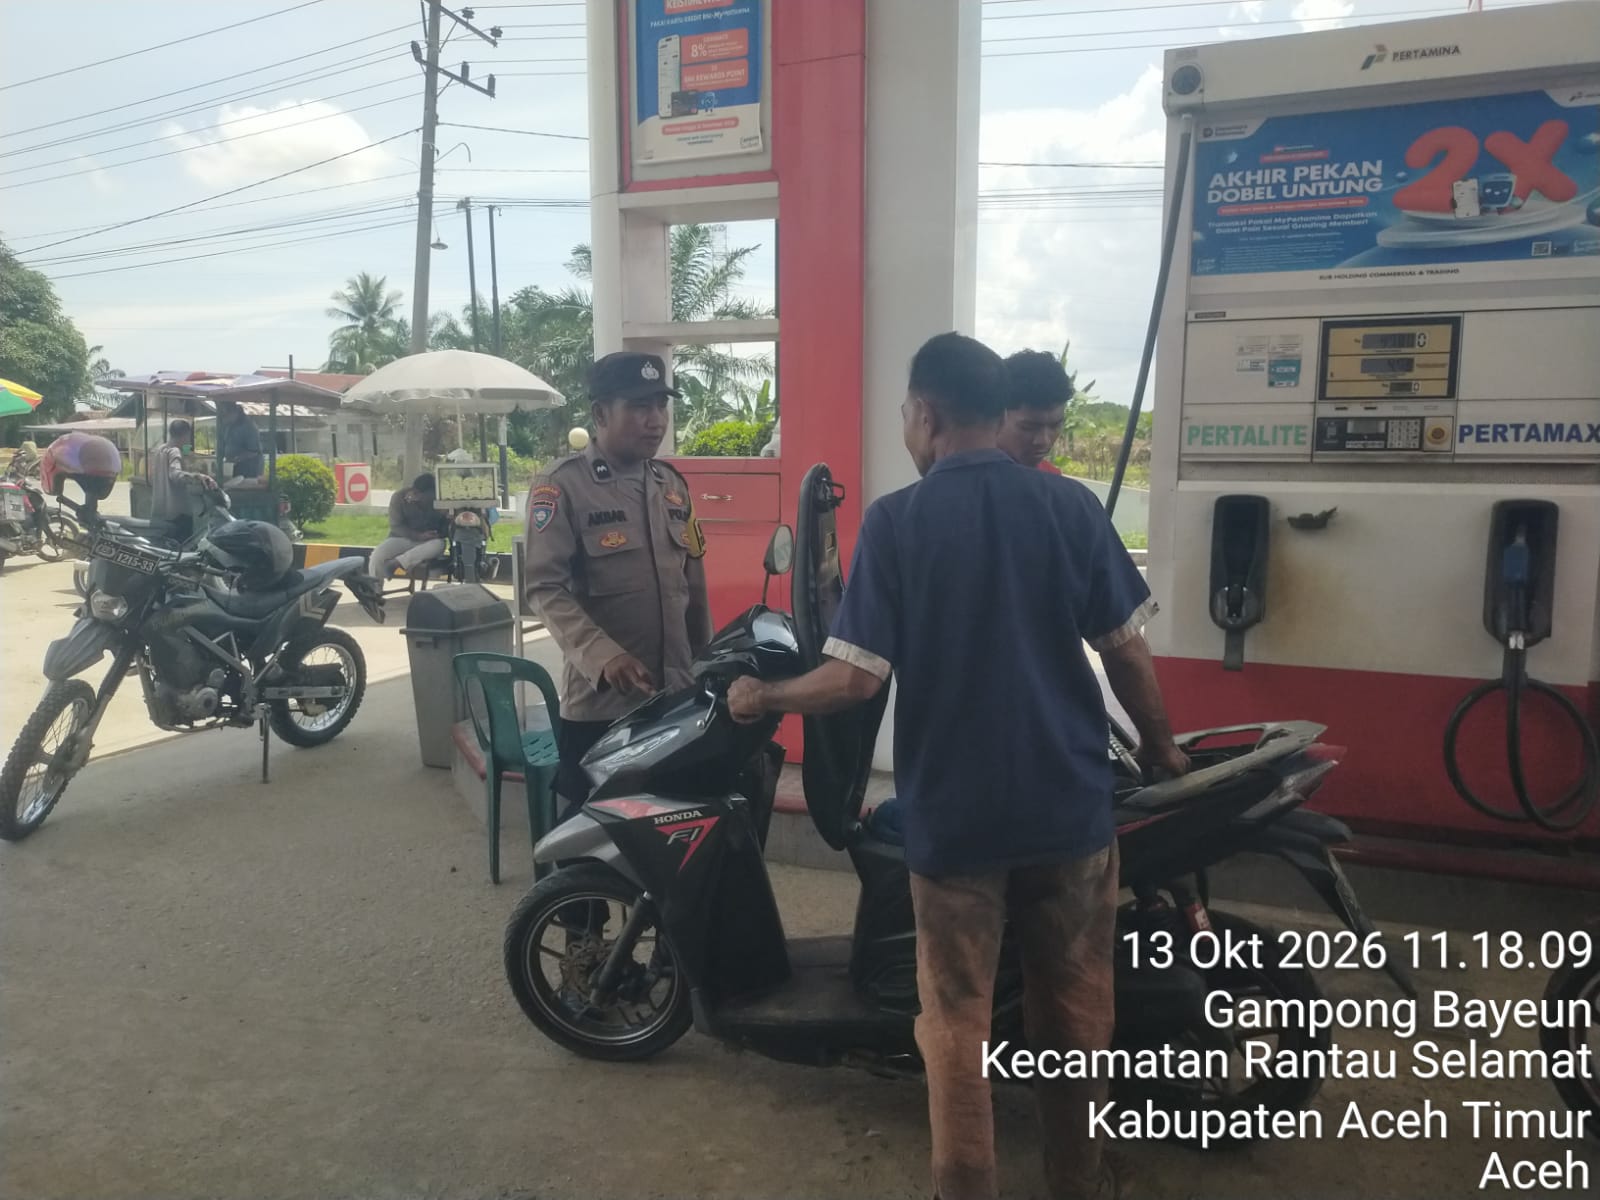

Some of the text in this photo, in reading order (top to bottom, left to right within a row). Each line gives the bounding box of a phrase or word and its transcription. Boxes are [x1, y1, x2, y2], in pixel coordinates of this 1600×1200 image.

[691, 41, 708, 57] 8%
[1392, 45, 1461, 62] PERTAMINA
[1208, 159, 1383, 189] AKHIR PEKAN
[1392, 119, 1579, 215] 2X
[1207, 177, 1384, 204] DOBEL UNTUNG
[1334, 272, 1368, 280] HOLDING
[1369, 271, 1417, 279] COMMERCIAL
[1187, 424, 1308, 447] PERTALITE
[1458, 422, 1600, 444] PERTAMAX
[654, 810, 703, 824] HONDA
